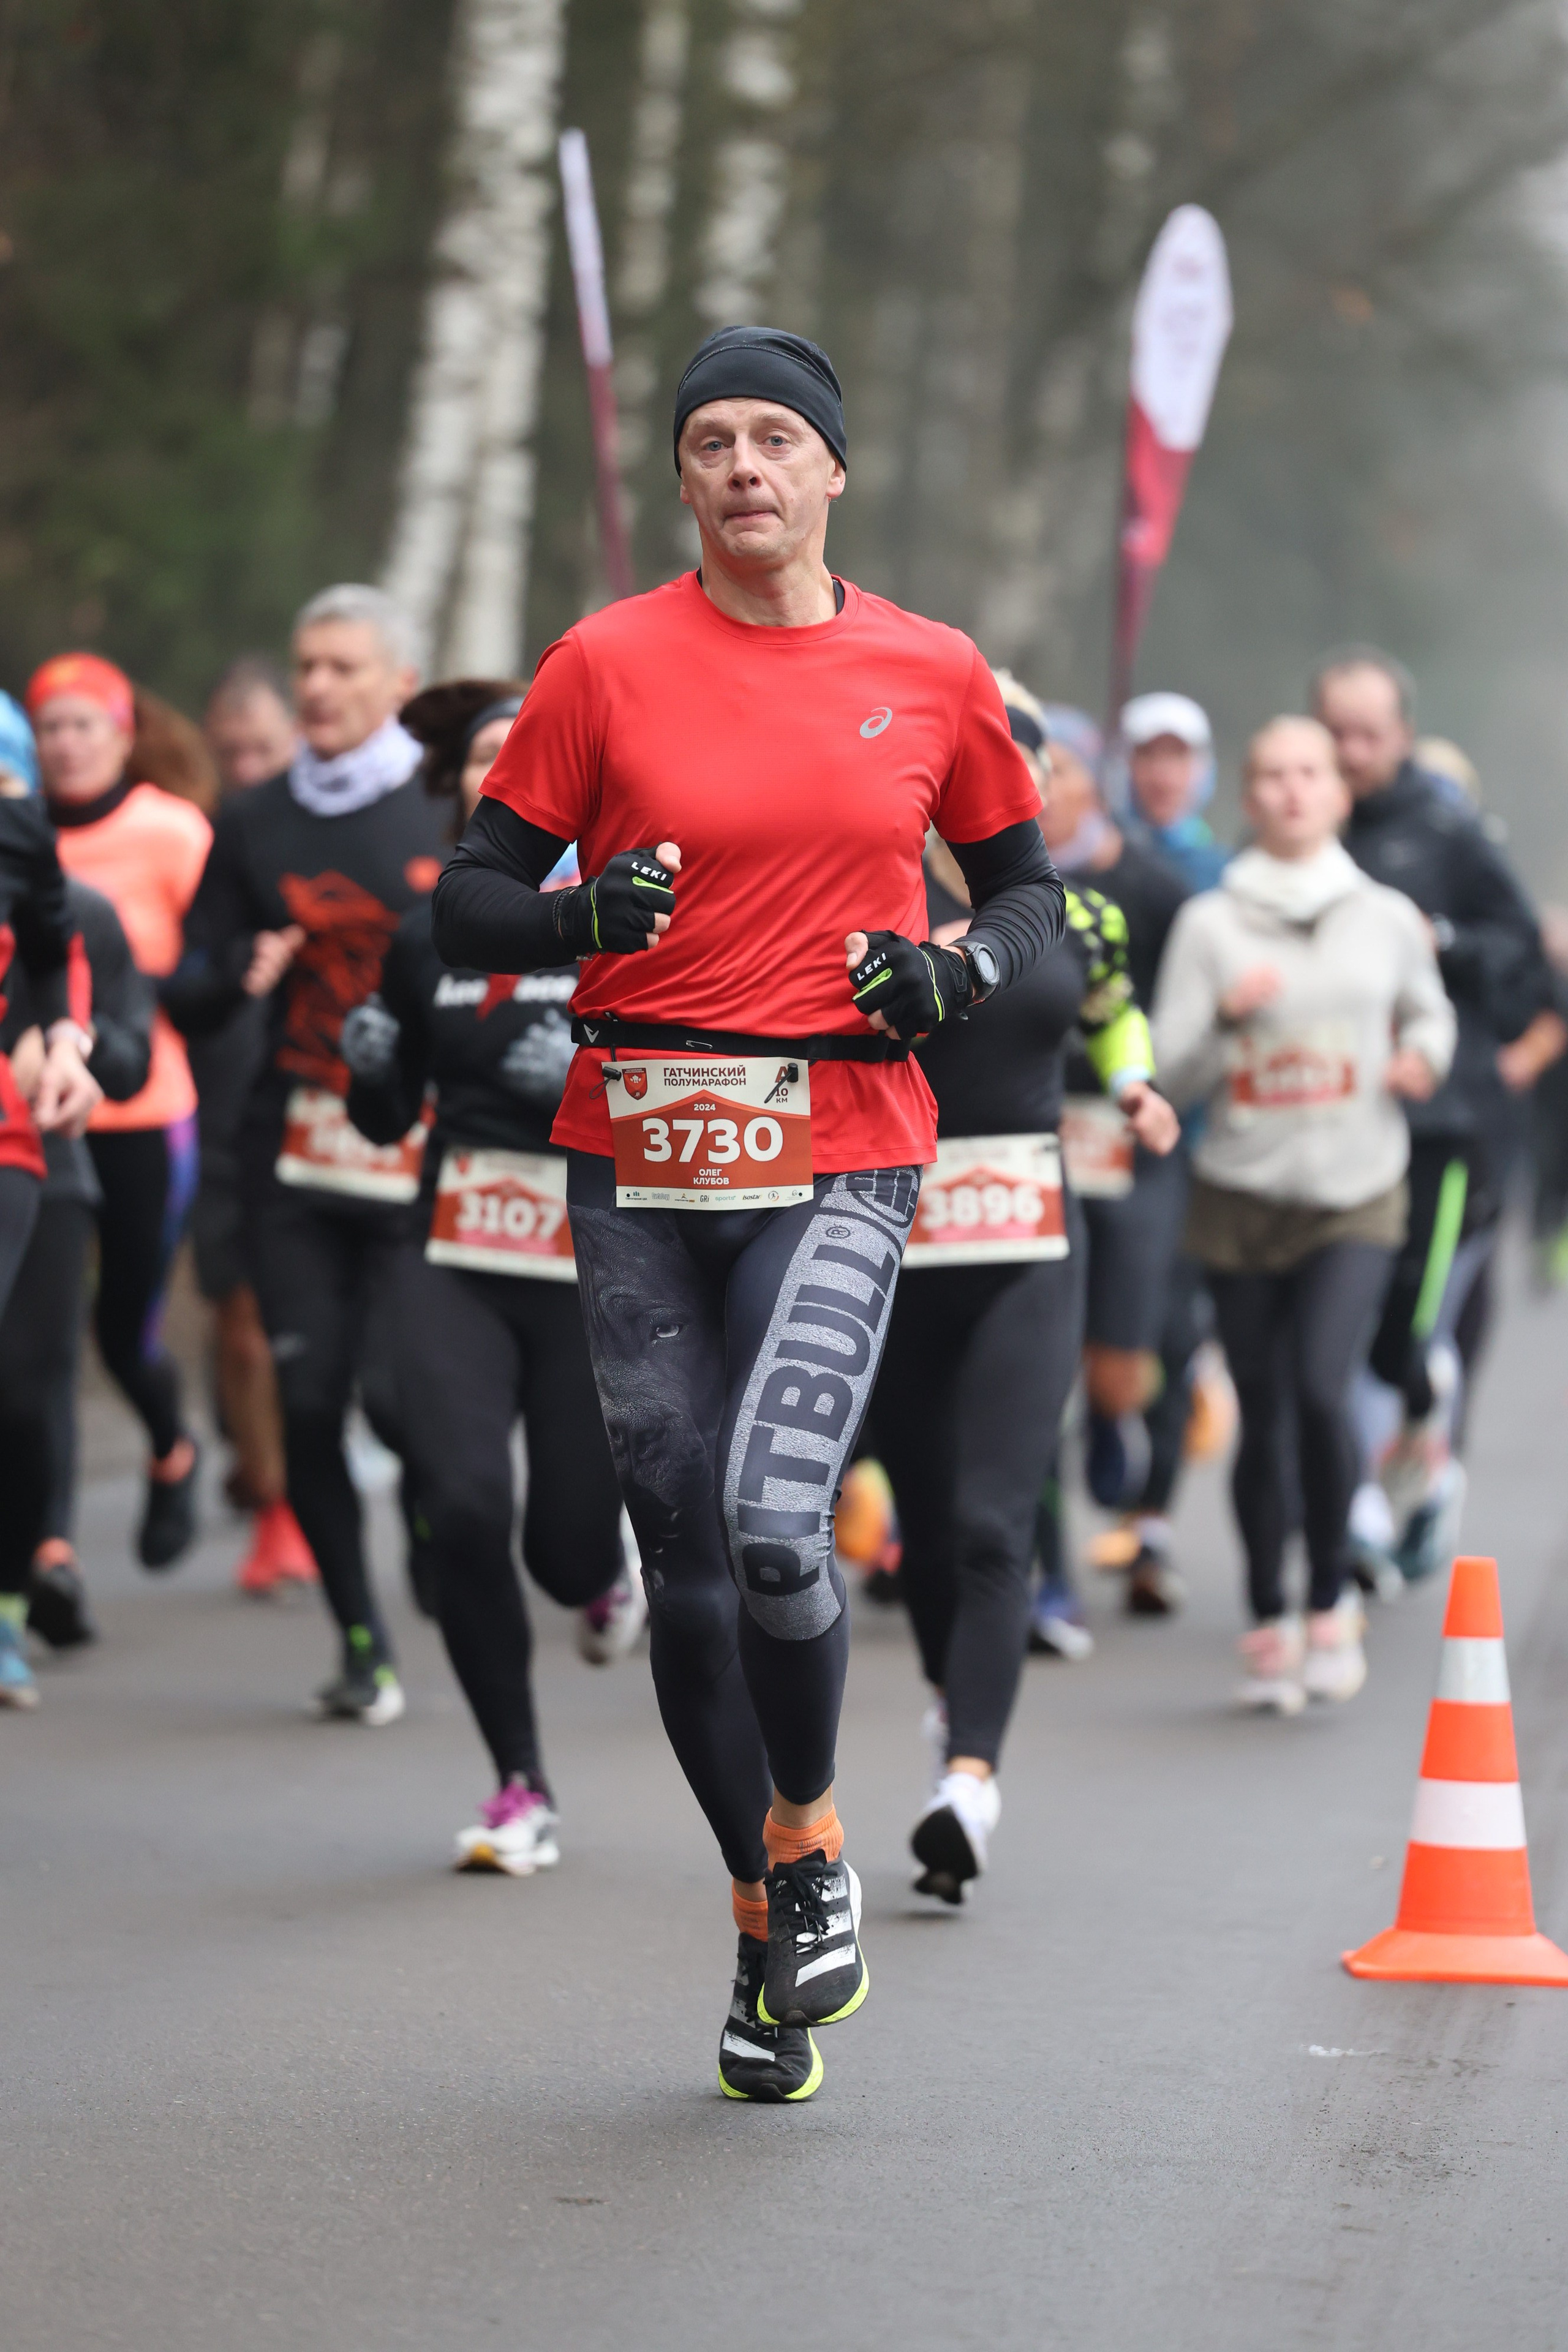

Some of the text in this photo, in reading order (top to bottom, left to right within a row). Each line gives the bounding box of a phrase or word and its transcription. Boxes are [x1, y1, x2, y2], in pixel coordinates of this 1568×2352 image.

[631, 861, 667, 881] LEKI
[857, 952, 887, 981] LEKI
[663, 1065, 746, 1077] ГАТЧИНСКИЙ
[664, 1077, 746, 1086] ПОЛУМАРАФОН
[775, 1088, 788, 1096] 10
[642, 1116, 784, 1164] 3730
[693, 1177, 729, 1185] КЛУБОВ
[919, 1183, 1045, 1229] 3896
[454, 1191, 565, 1242] 3107
